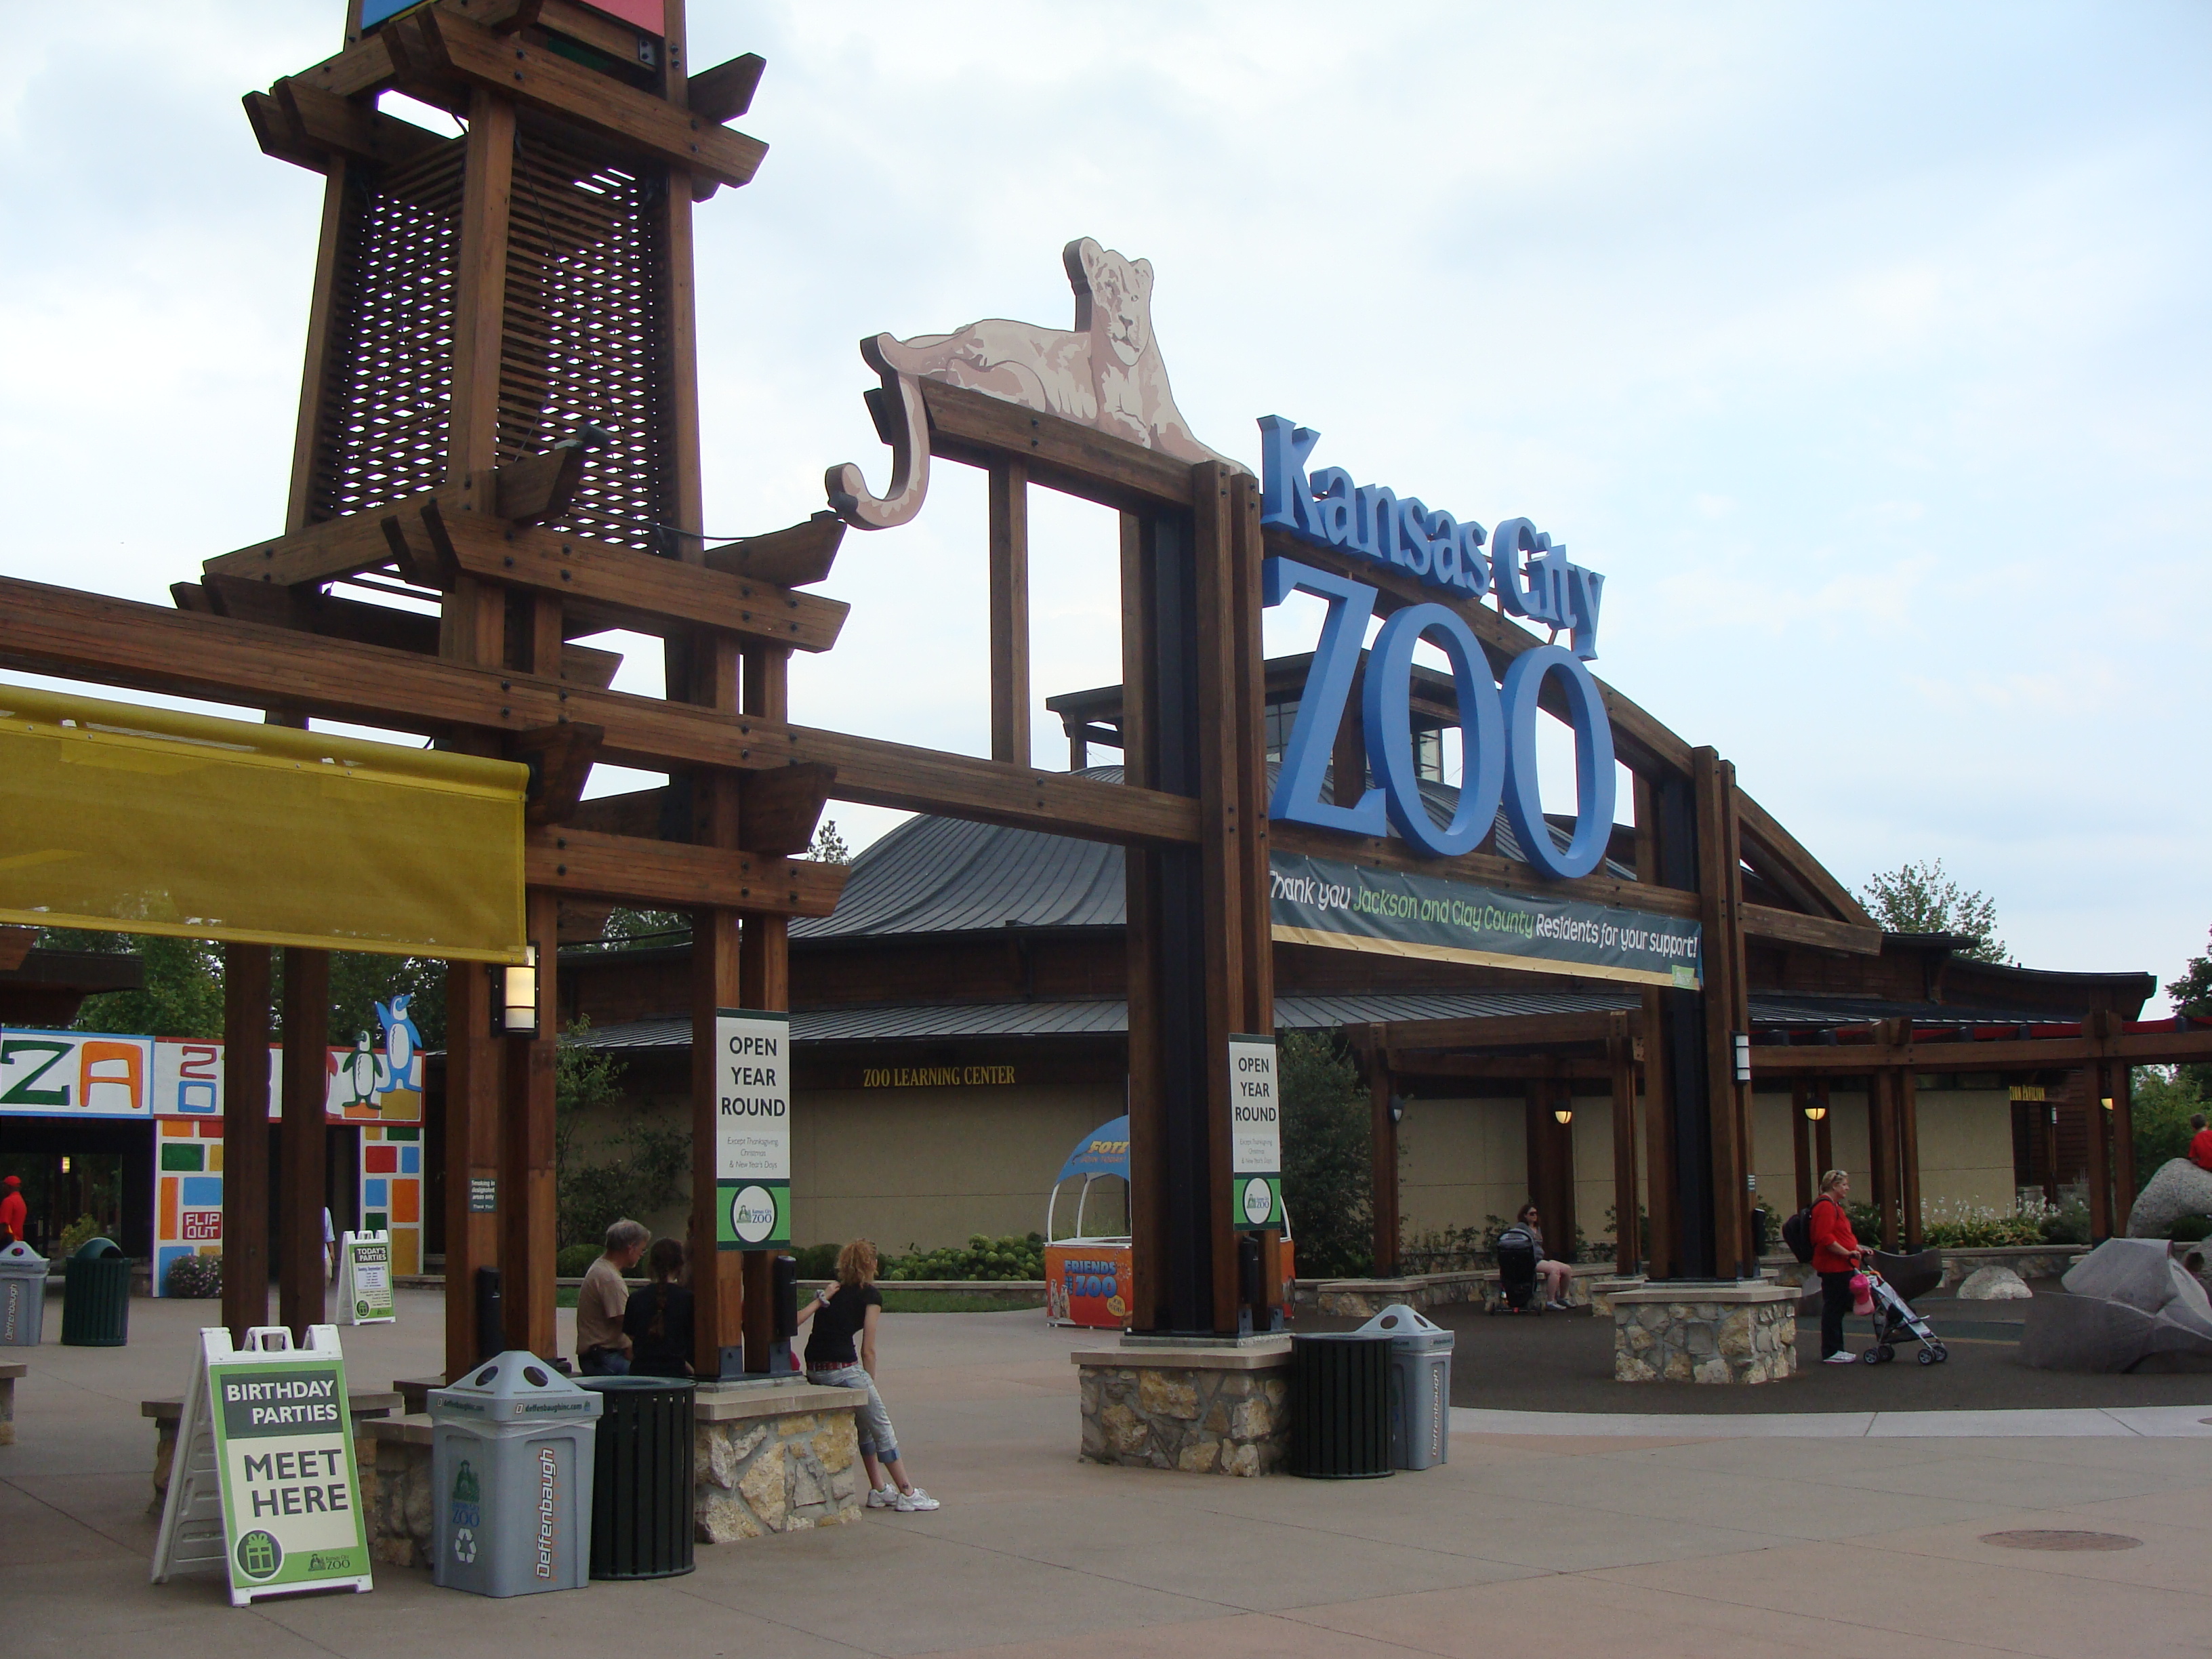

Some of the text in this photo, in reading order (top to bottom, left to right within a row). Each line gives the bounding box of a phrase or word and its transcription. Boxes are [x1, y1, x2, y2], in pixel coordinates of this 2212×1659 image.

[1256, 414, 1605, 661] Kansas City
[1262, 556, 1616, 879] ZOO
[1318, 882, 1351, 911] you
[1353, 886, 1418, 920] Jackson
[1421, 898, 1450, 924] and
[1452, 901, 1482, 933] Clay
[1484, 905, 1534, 939] County
[1536, 914, 1599, 944] Residents
[1599, 922, 1618, 949] for
[1620, 928, 1648, 952] your
[1650, 935, 1698, 958] support!
[729, 1037, 777, 1056] OPEN
[1238, 1057, 1269, 1073] OPEN
[731, 1067, 776, 1086] YEAR
[863, 1066, 1015, 1087] ZOO LEARNING CENTER
[1240, 1082, 1270, 1098] YEAR
[722, 1097, 785, 1117] ROUND
[1235, 1107, 1276, 1122] ROUND
[728, 1137, 745, 1145] Except
[764, 1161, 777, 1170] Days
[186, 1213, 220, 1225] FLIP
[752, 1214, 772, 1223] ZOO
[187, 1226, 218, 1238] OUT
[359, 1254, 386, 1262] PARTIES
[1065, 1260, 1117, 1275] FRIENDS
[1076, 1275, 1118, 1298] ZOO
[5, 1284, 18, 1340] Deffenbaugh
[227, 1380, 334, 1402] BIRTHDAY
[253, 1403, 338, 1425] PARTIES
[525, 1403, 582, 1412] deffenbaughinc.com
[244, 1448, 342, 1482] MEET
[252, 1483, 349, 1517] HERE
[453, 1509, 480, 1527] ZOO
[536, 1448, 556, 1578] Deffenbaugh
[326, 1559, 350, 1570] ZOO
